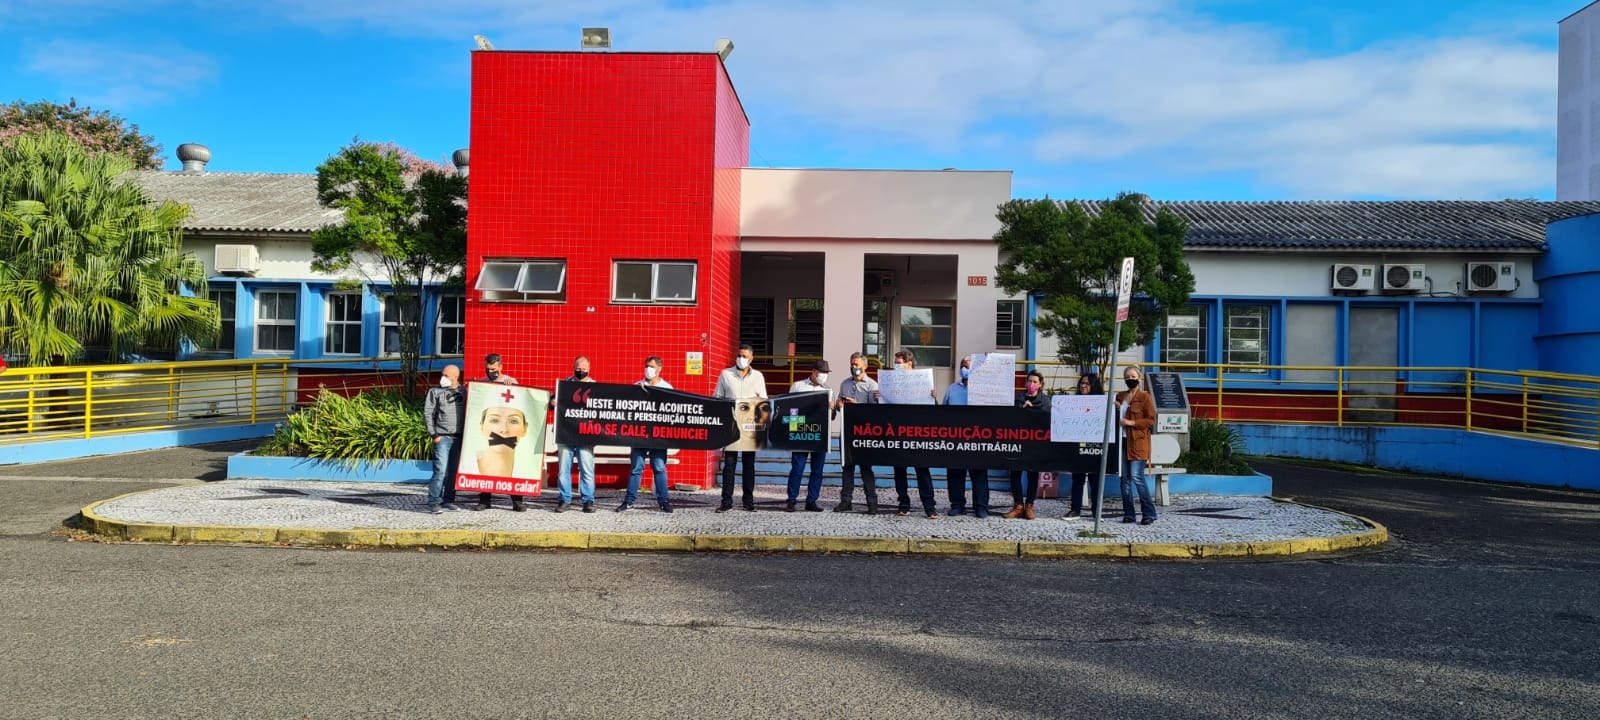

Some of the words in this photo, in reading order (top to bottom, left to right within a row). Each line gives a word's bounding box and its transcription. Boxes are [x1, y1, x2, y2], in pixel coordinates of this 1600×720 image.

[615, 400, 657, 412] HOSPITAL
[659, 402, 704, 415] ACONTECE
[565, 408, 597, 419] ASSÉDIO
[599, 411, 625, 421] MORAL
[628, 412, 633, 421] E
[634, 412, 685, 425] PERSEGUIÇÃO
[579, 420, 602, 435] NÃO
[605, 423, 617, 436] SE
[620, 424, 649, 439] CALE,
[653, 425, 709, 440] DENUNCIE!
[798, 424, 822, 433] SINDI
[853, 423, 883, 437] NÃO
[886, 423, 896, 437] À
[898, 424, 992, 441] PERSEGUIÇÃO
[995, 427, 1051, 441] SINDICA
[852, 439, 886, 449] CHEGA
[887, 440, 901, 449] DE
[902, 440, 955, 451] DEMISSÃO
[956, 441, 1022, 453] ARBITRÁRIA!
[458, 475, 494, 489] Querem
[496, 480, 513, 491] nos
[514, 481, 540, 493] calar!
